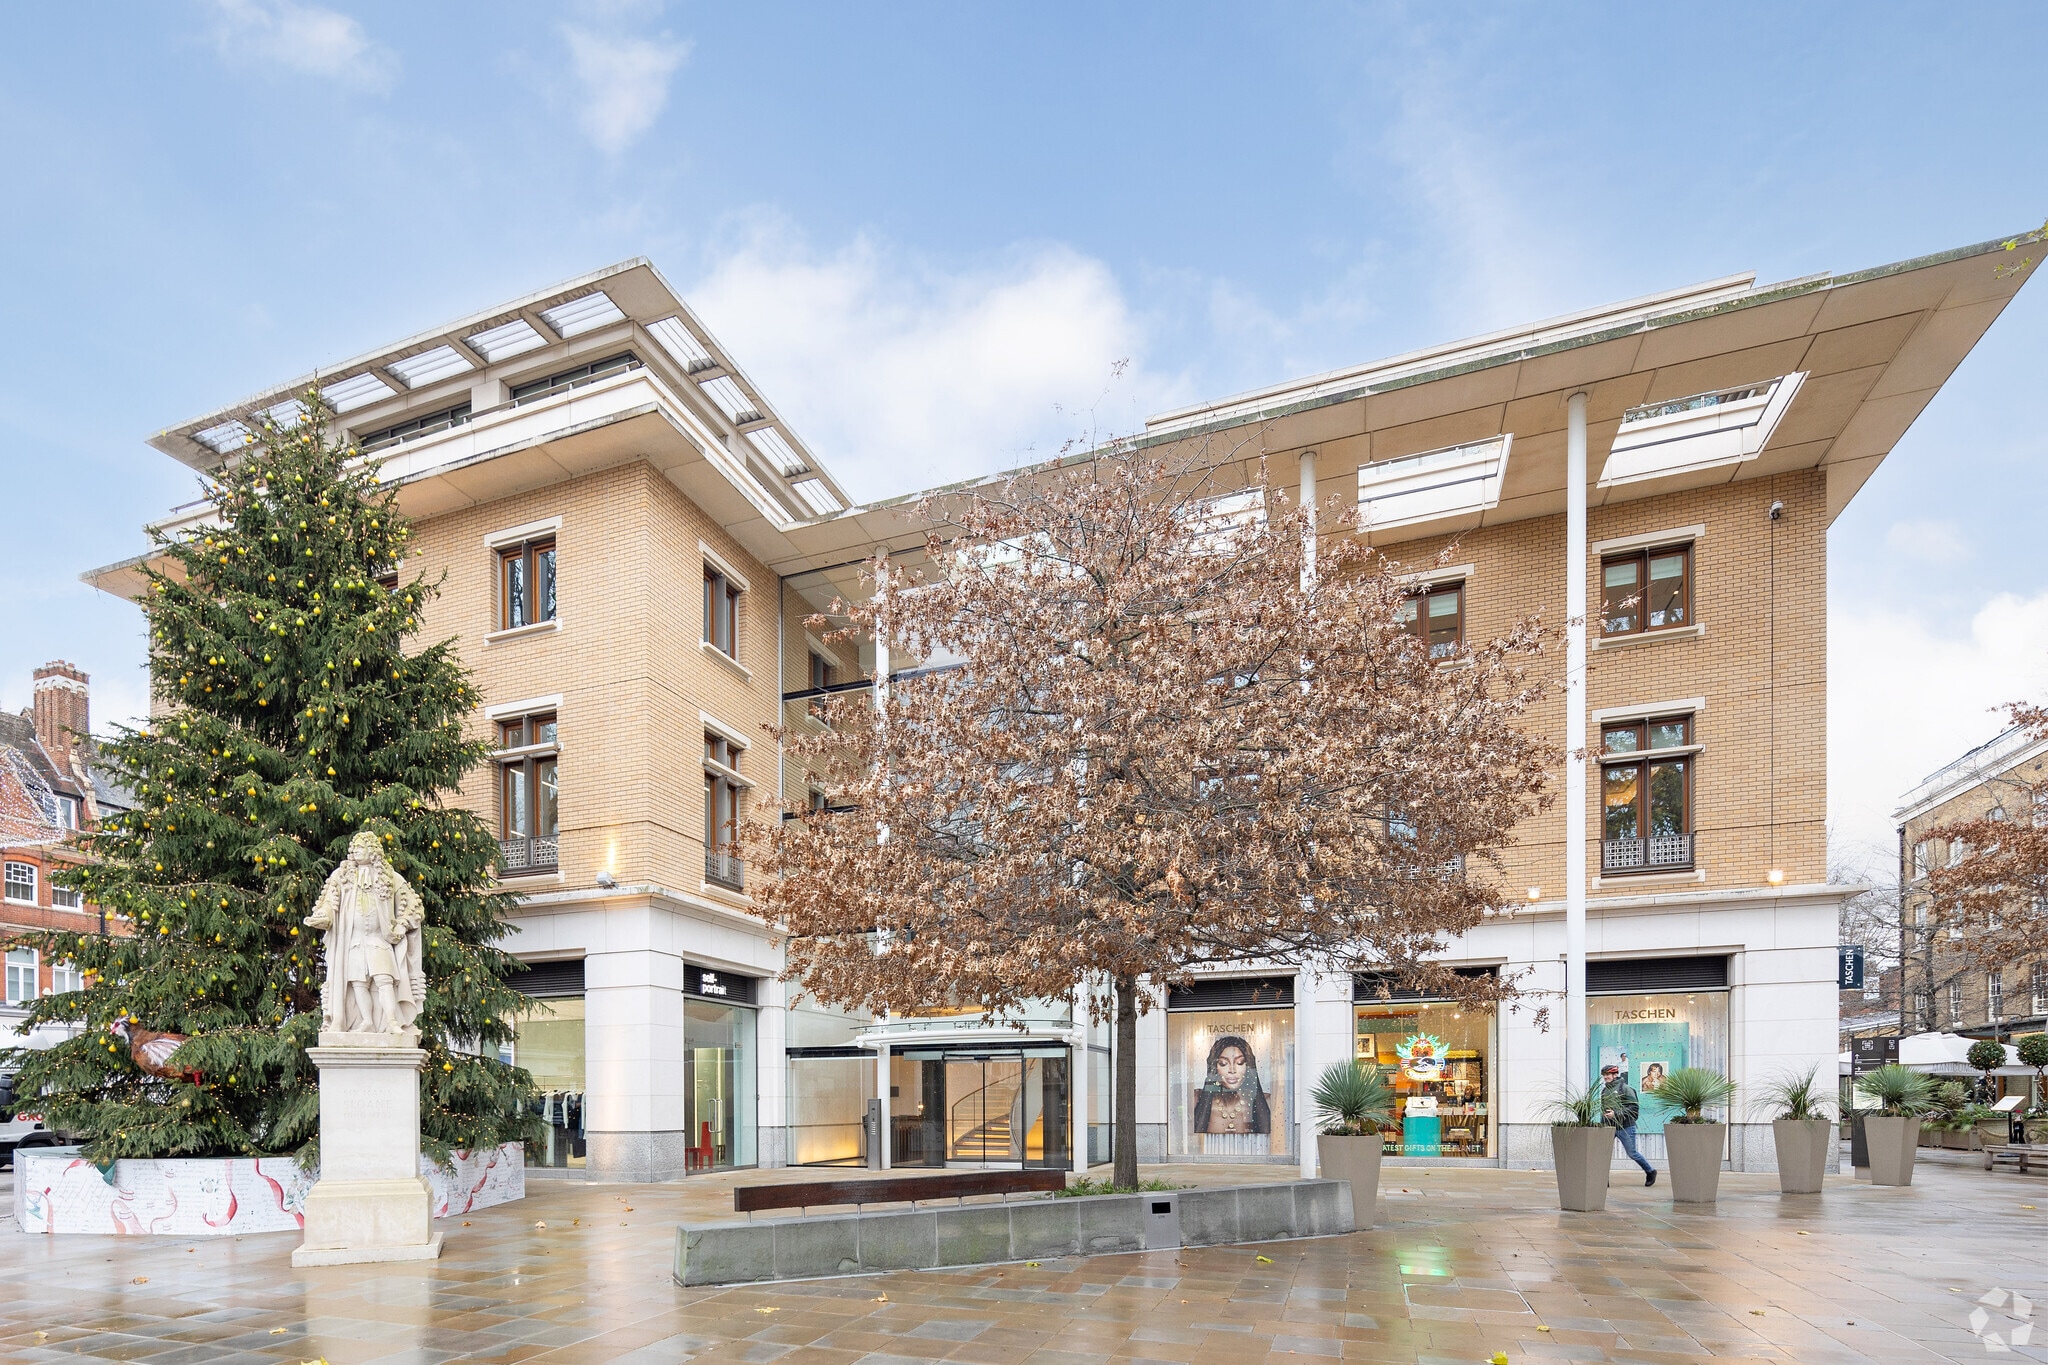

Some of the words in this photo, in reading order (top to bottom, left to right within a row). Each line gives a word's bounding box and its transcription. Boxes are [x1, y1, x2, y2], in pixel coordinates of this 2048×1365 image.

[1845, 949, 1854, 985] TASCHEN
[702, 983, 727, 995] portrait
[1614, 1008, 1676, 1019] TASCHEN
[1207, 1024, 1254, 1033] TASCHEN
[1404, 1144, 1424, 1152] GIFTS
[1425, 1144, 1436, 1152] ON
[1437, 1144, 1451, 1152] THE
